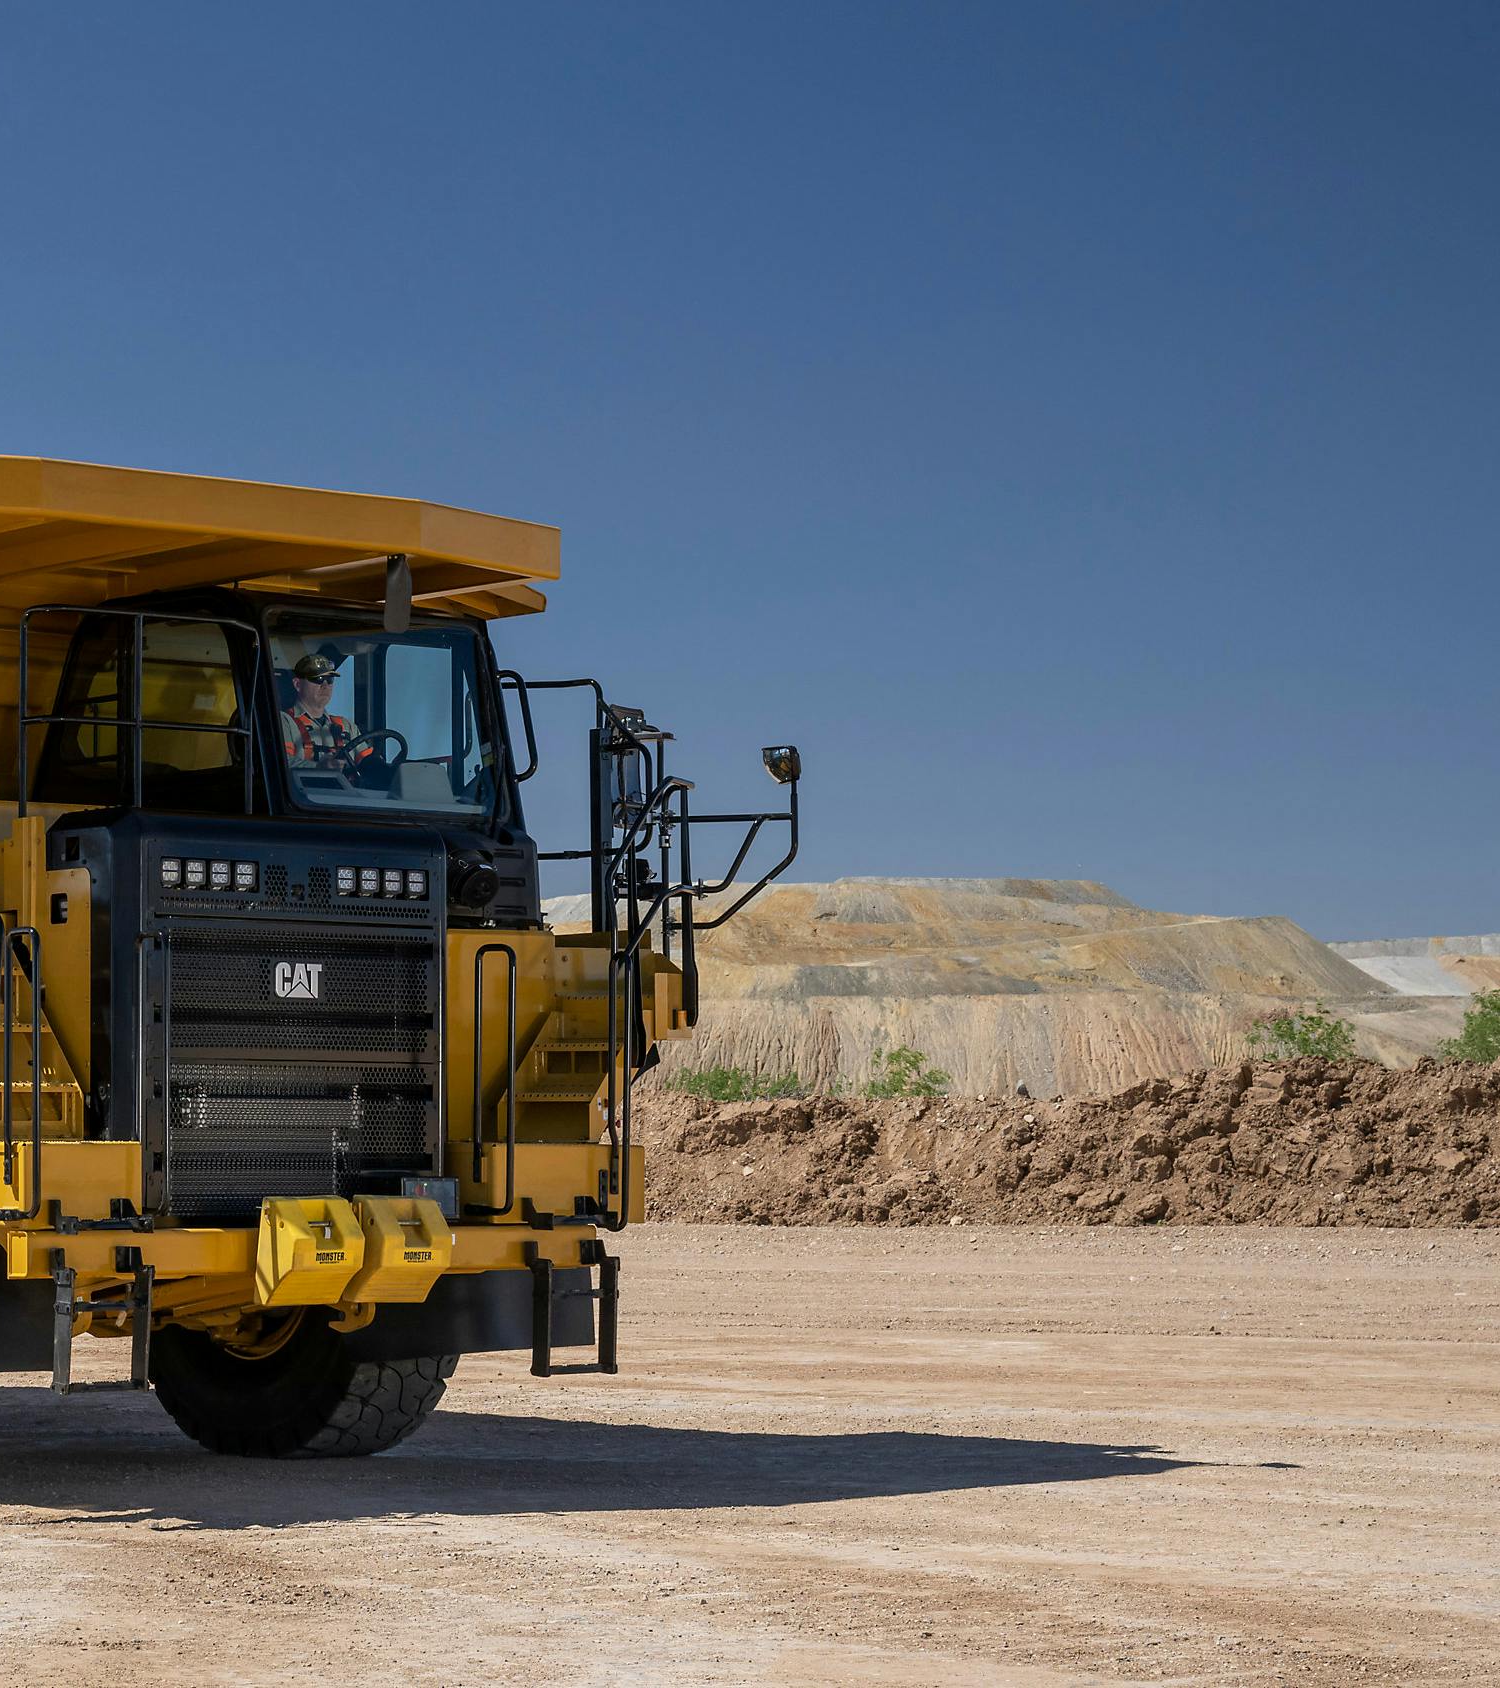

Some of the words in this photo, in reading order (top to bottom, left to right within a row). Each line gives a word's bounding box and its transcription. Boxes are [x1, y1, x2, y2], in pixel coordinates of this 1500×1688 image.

[275, 961, 322, 998] CAT
[316, 1251, 345, 1261] MONSTER
[404, 1251, 432, 1260] MONSTER
